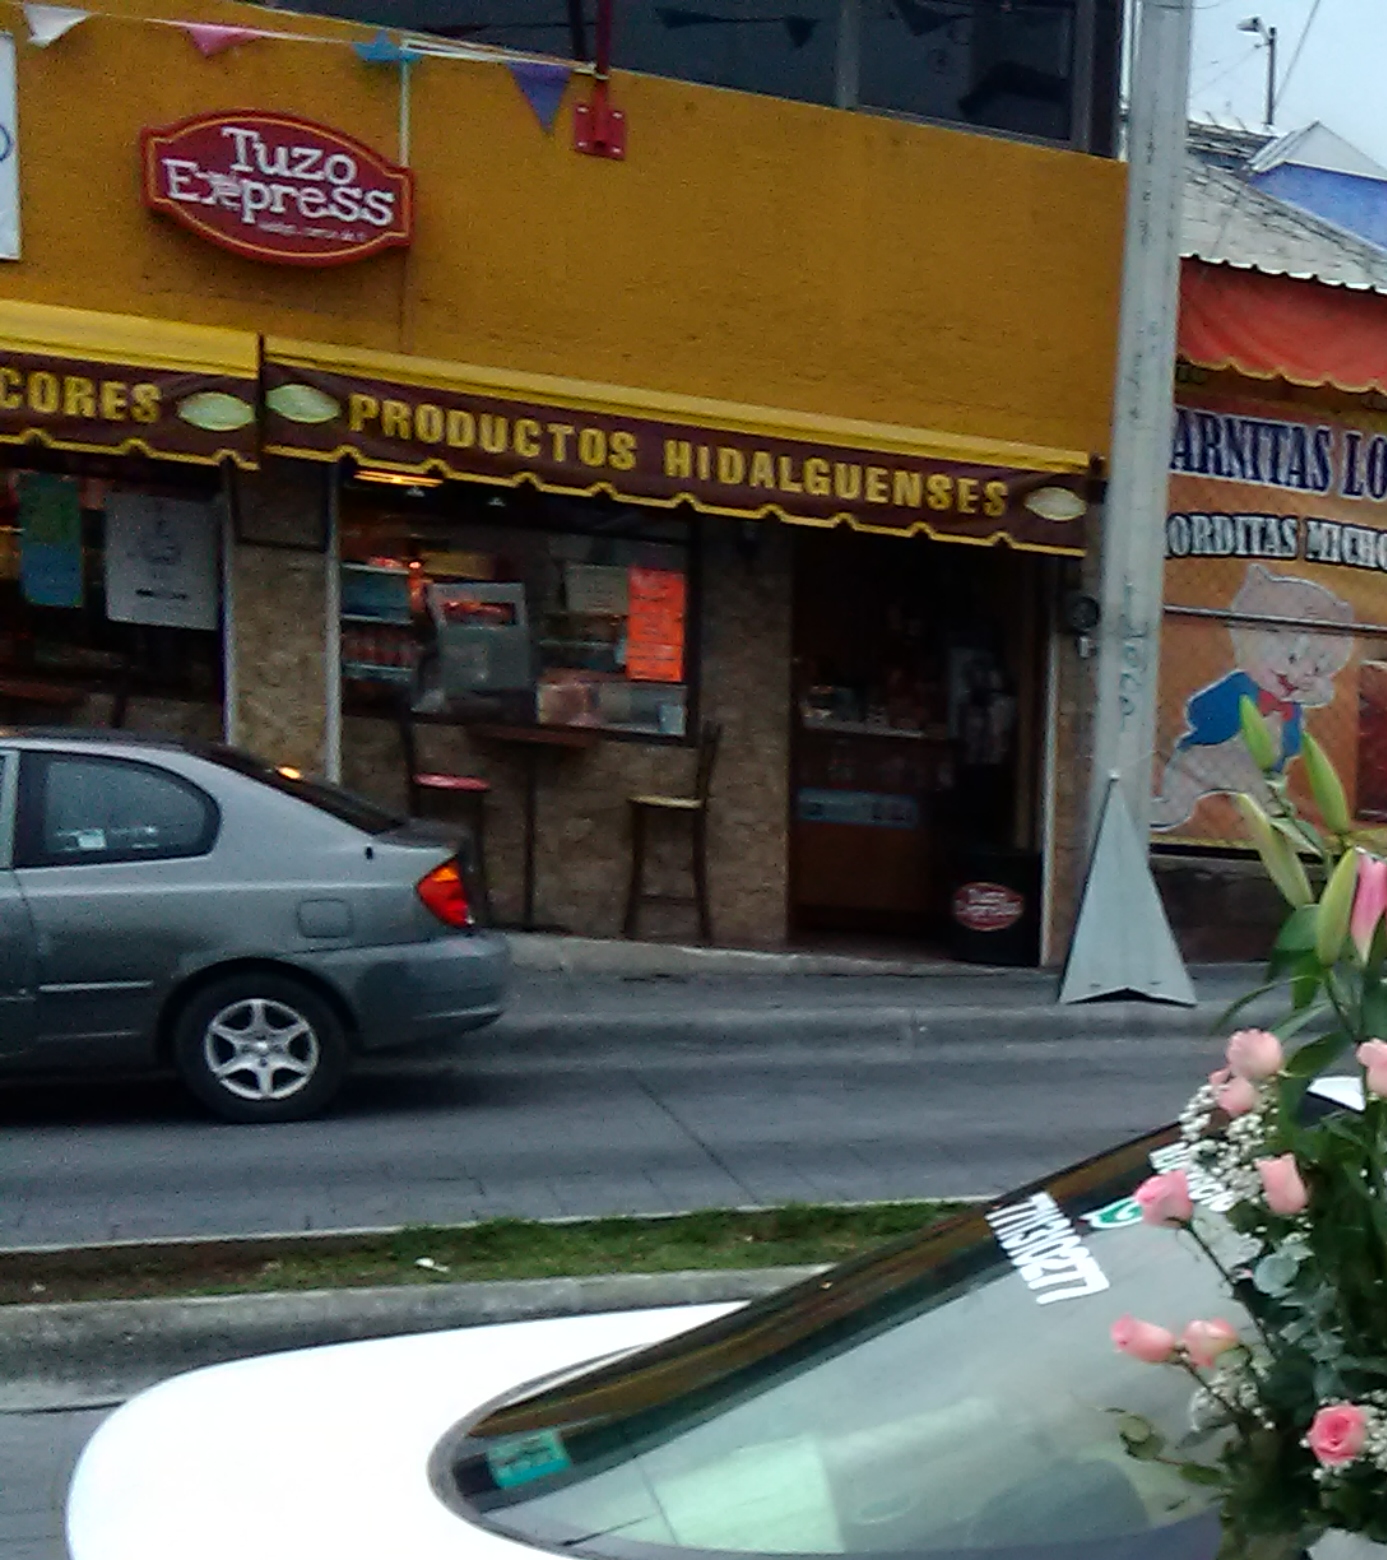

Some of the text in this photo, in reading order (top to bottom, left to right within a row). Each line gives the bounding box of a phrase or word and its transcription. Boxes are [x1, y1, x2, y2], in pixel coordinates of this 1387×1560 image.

[221, 126, 357, 186] Tuzo
[162, 158, 396, 226] Express
[350, 393, 1010, 518] PRODUCTOS HIDALGUENSES
[1170, 408, 1331, 492] ARNITAS
[1165, 513, 1298, 559] ORDITAS
